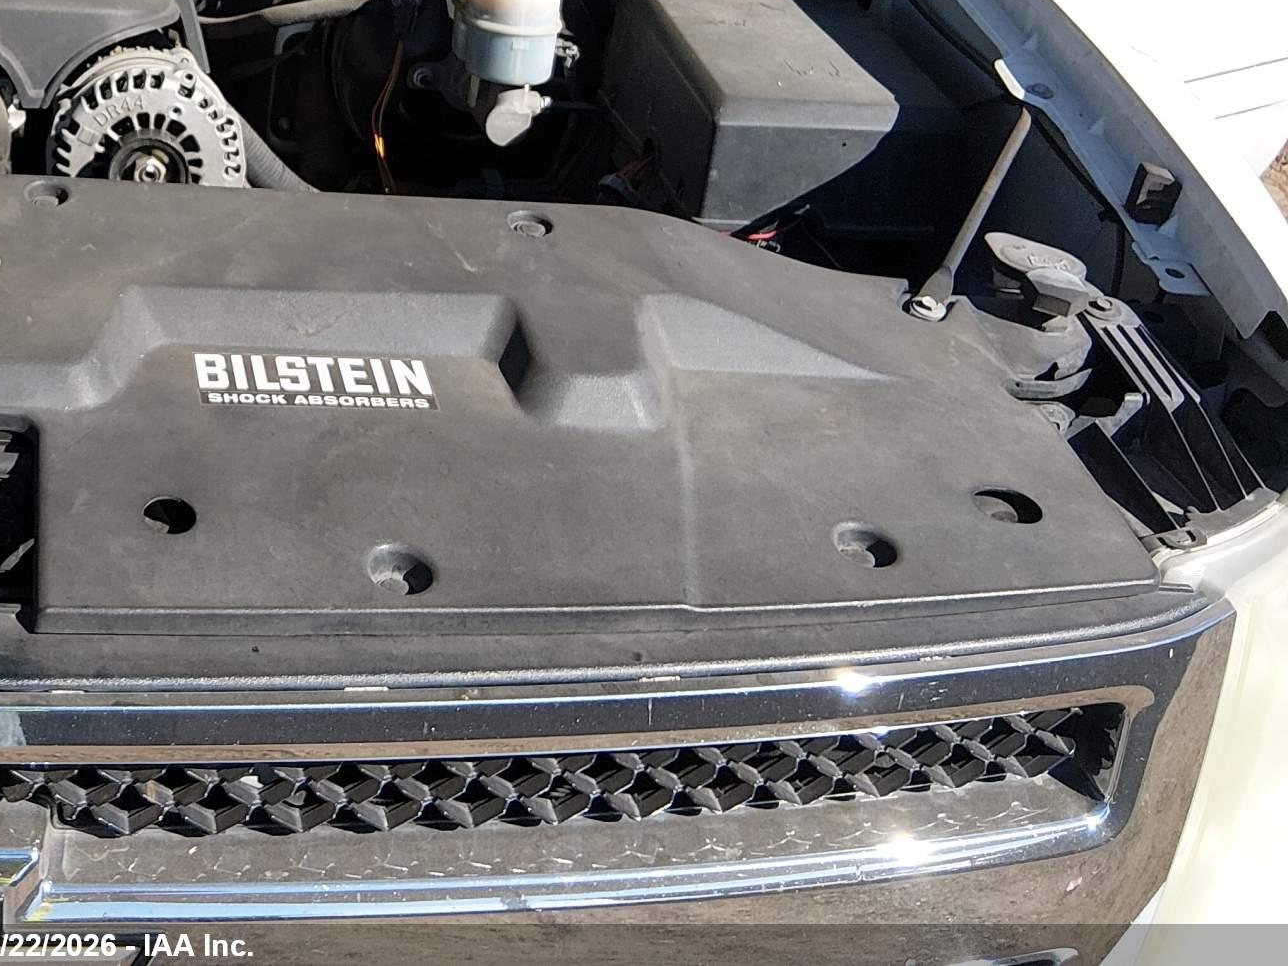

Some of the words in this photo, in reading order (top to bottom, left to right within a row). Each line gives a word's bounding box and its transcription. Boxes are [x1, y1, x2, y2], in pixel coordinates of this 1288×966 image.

[194, 353, 433, 395] BILSTEIN
[208, 392, 287, 405] SHOCK
[294, 394, 430, 409] ABSORBERS
